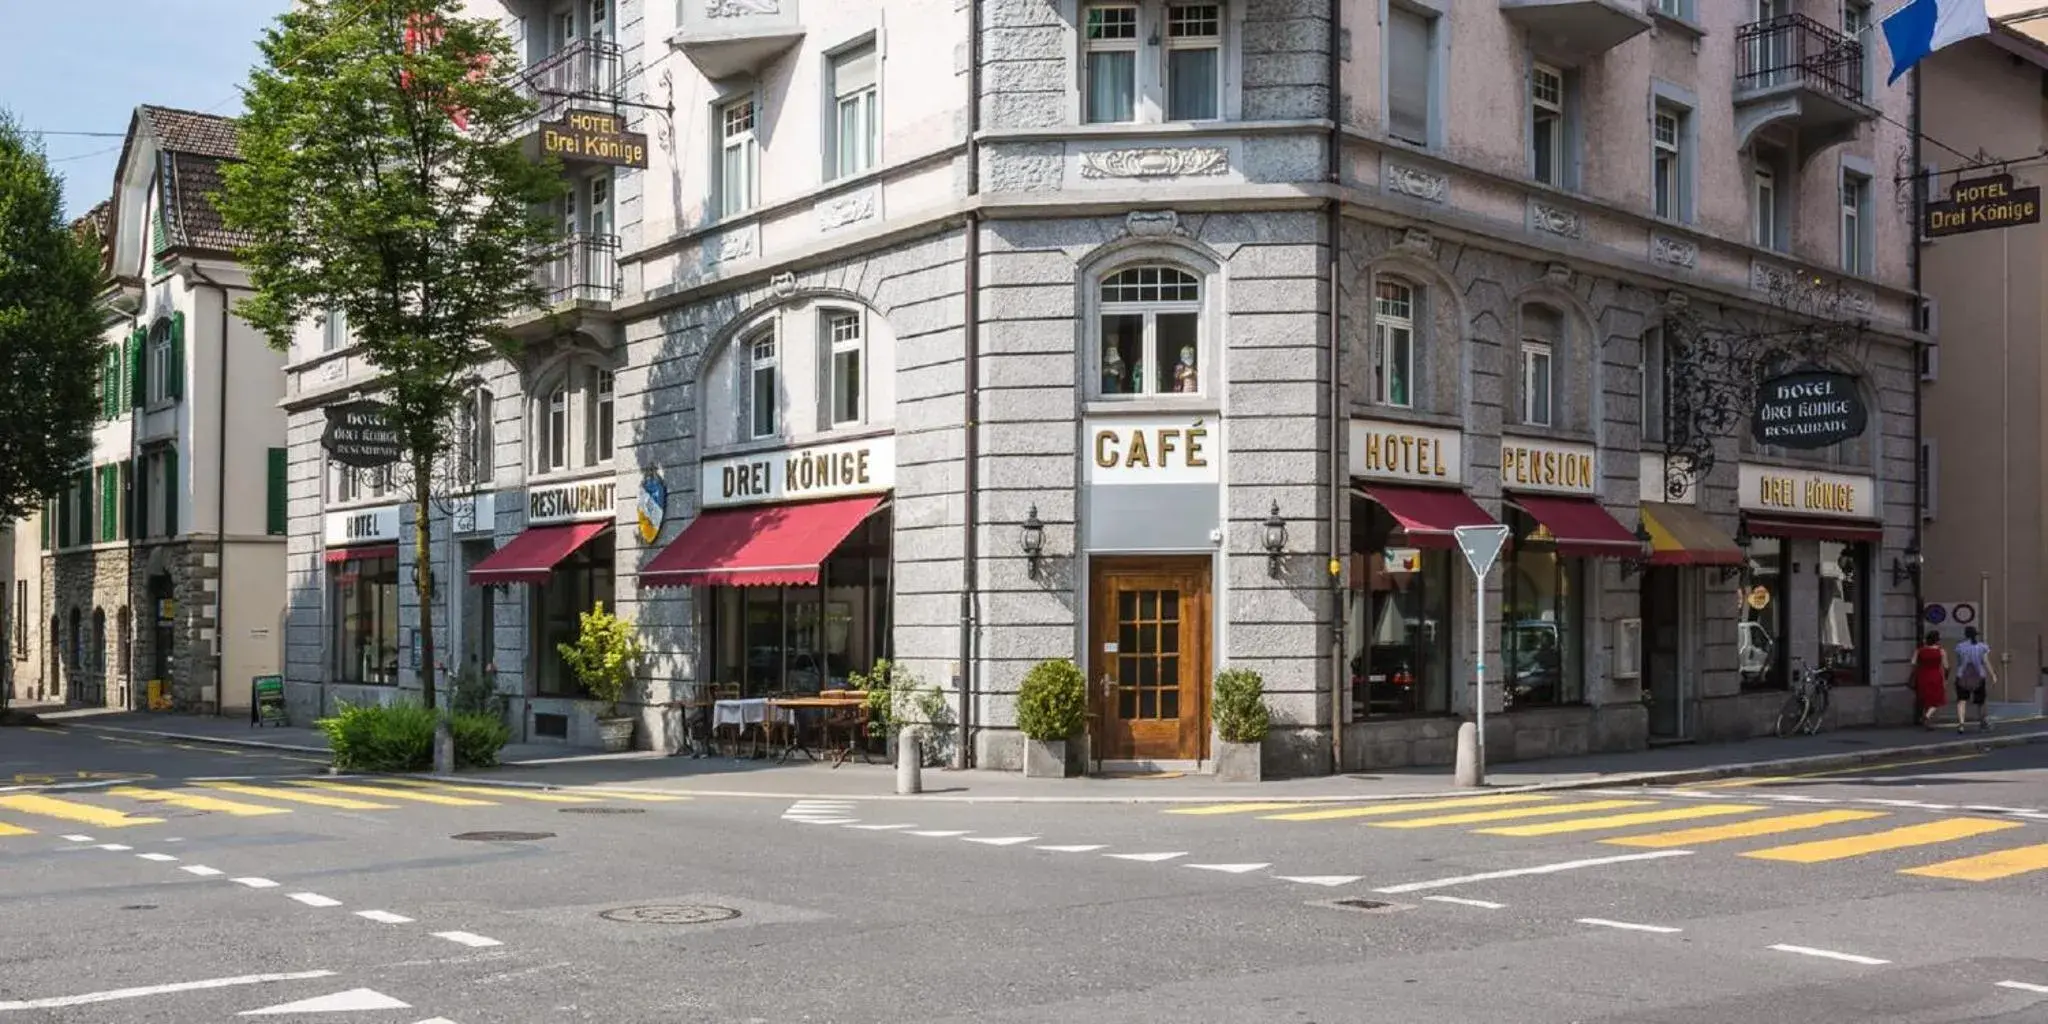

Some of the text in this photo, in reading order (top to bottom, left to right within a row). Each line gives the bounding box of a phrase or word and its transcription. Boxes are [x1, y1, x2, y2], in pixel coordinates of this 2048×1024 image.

[570, 114, 619, 135] HOTEL
[544, 130, 643, 164] Drei Könige
[1956, 183, 2009, 203] HOTEL
[1931, 201, 2034, 229] Drei Könige
[1095, 416, 1208, 468] CAFÉ
[1365, 432, 1446, 477] HOTEL
[722, 449, 870, 498] DREI KÖNIGE
[1503, 447, 1591, 488] PENSION
[530, 483, 616, 518] RESTAURANT
[1761, 474, 1854, 513] DREI KÖNIGE
[346, 513, 380, 538] HOTEL
